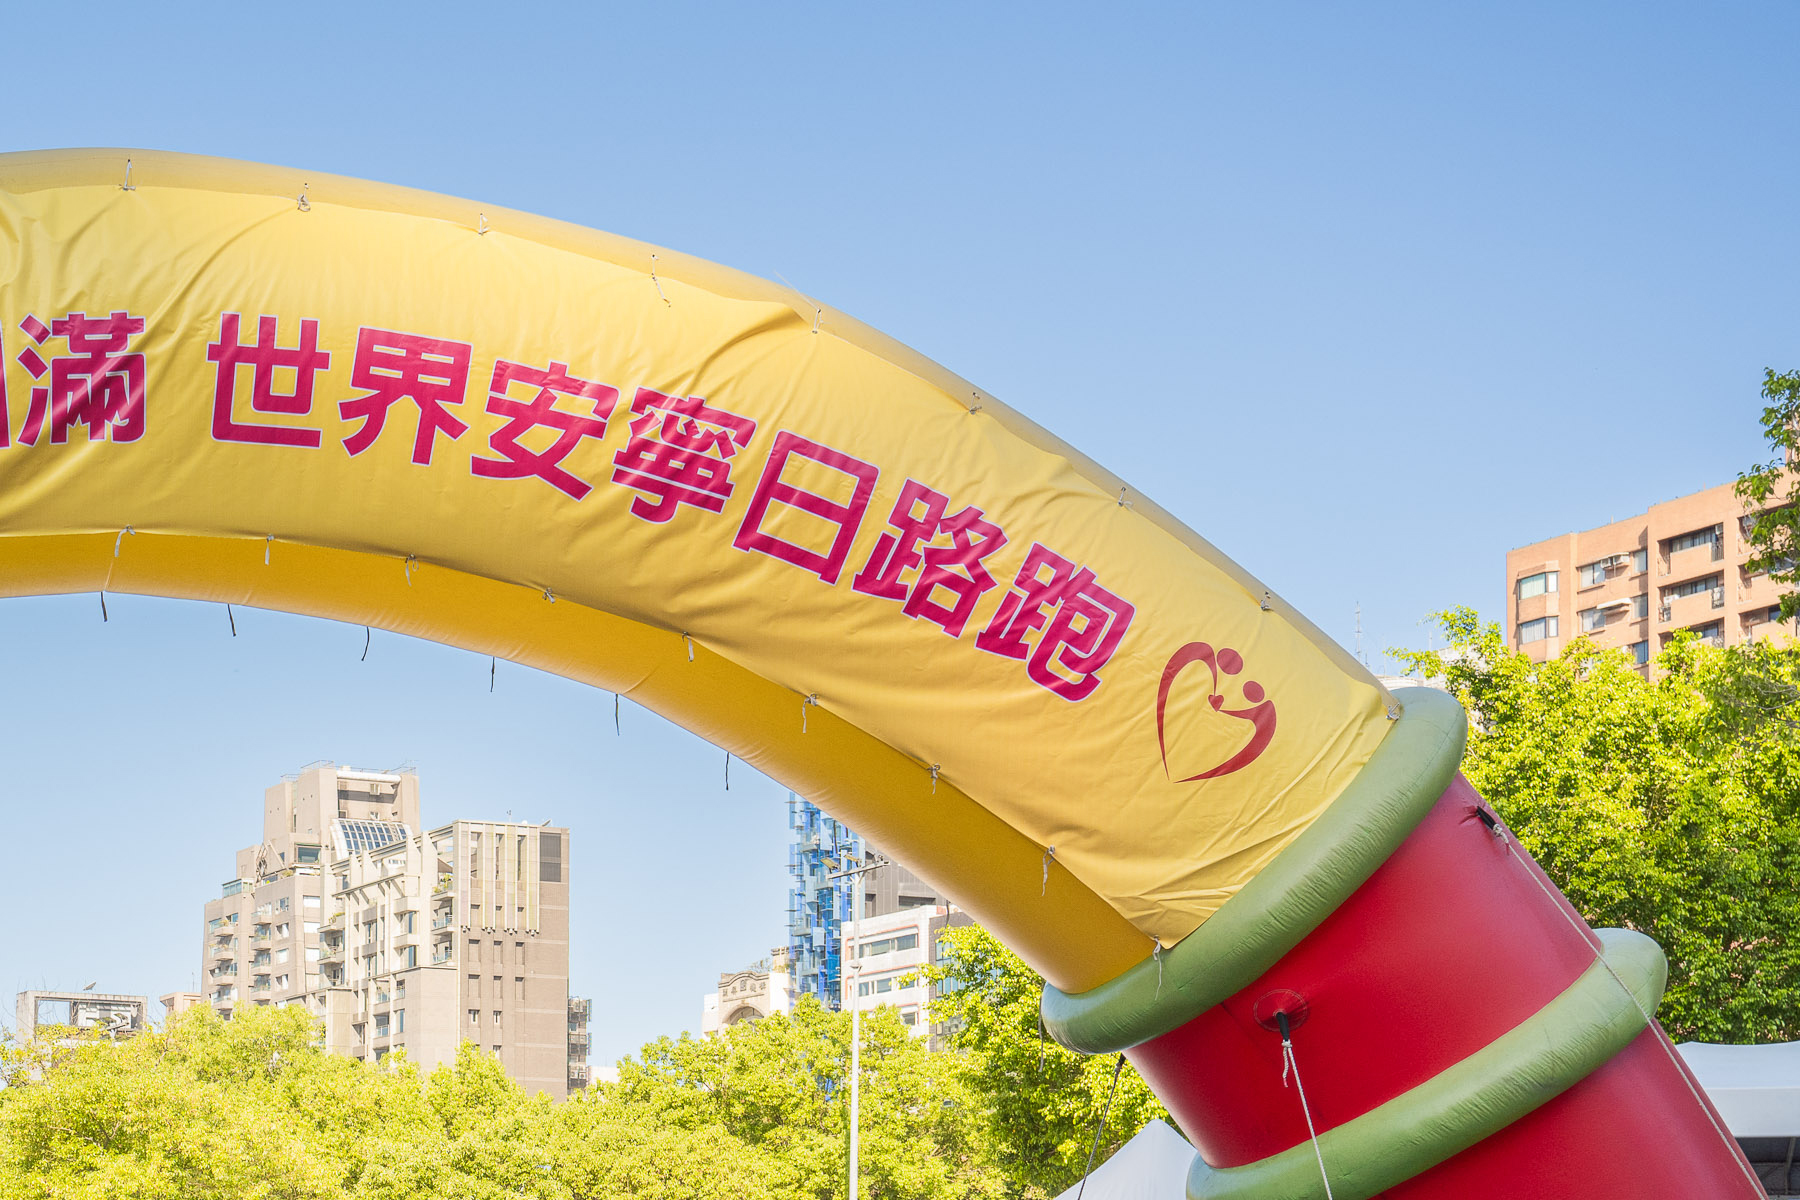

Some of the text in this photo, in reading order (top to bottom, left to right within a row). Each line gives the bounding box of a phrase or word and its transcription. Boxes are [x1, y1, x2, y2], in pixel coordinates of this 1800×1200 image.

[206, 311, 1137, 703] 世界安寧日路跑
